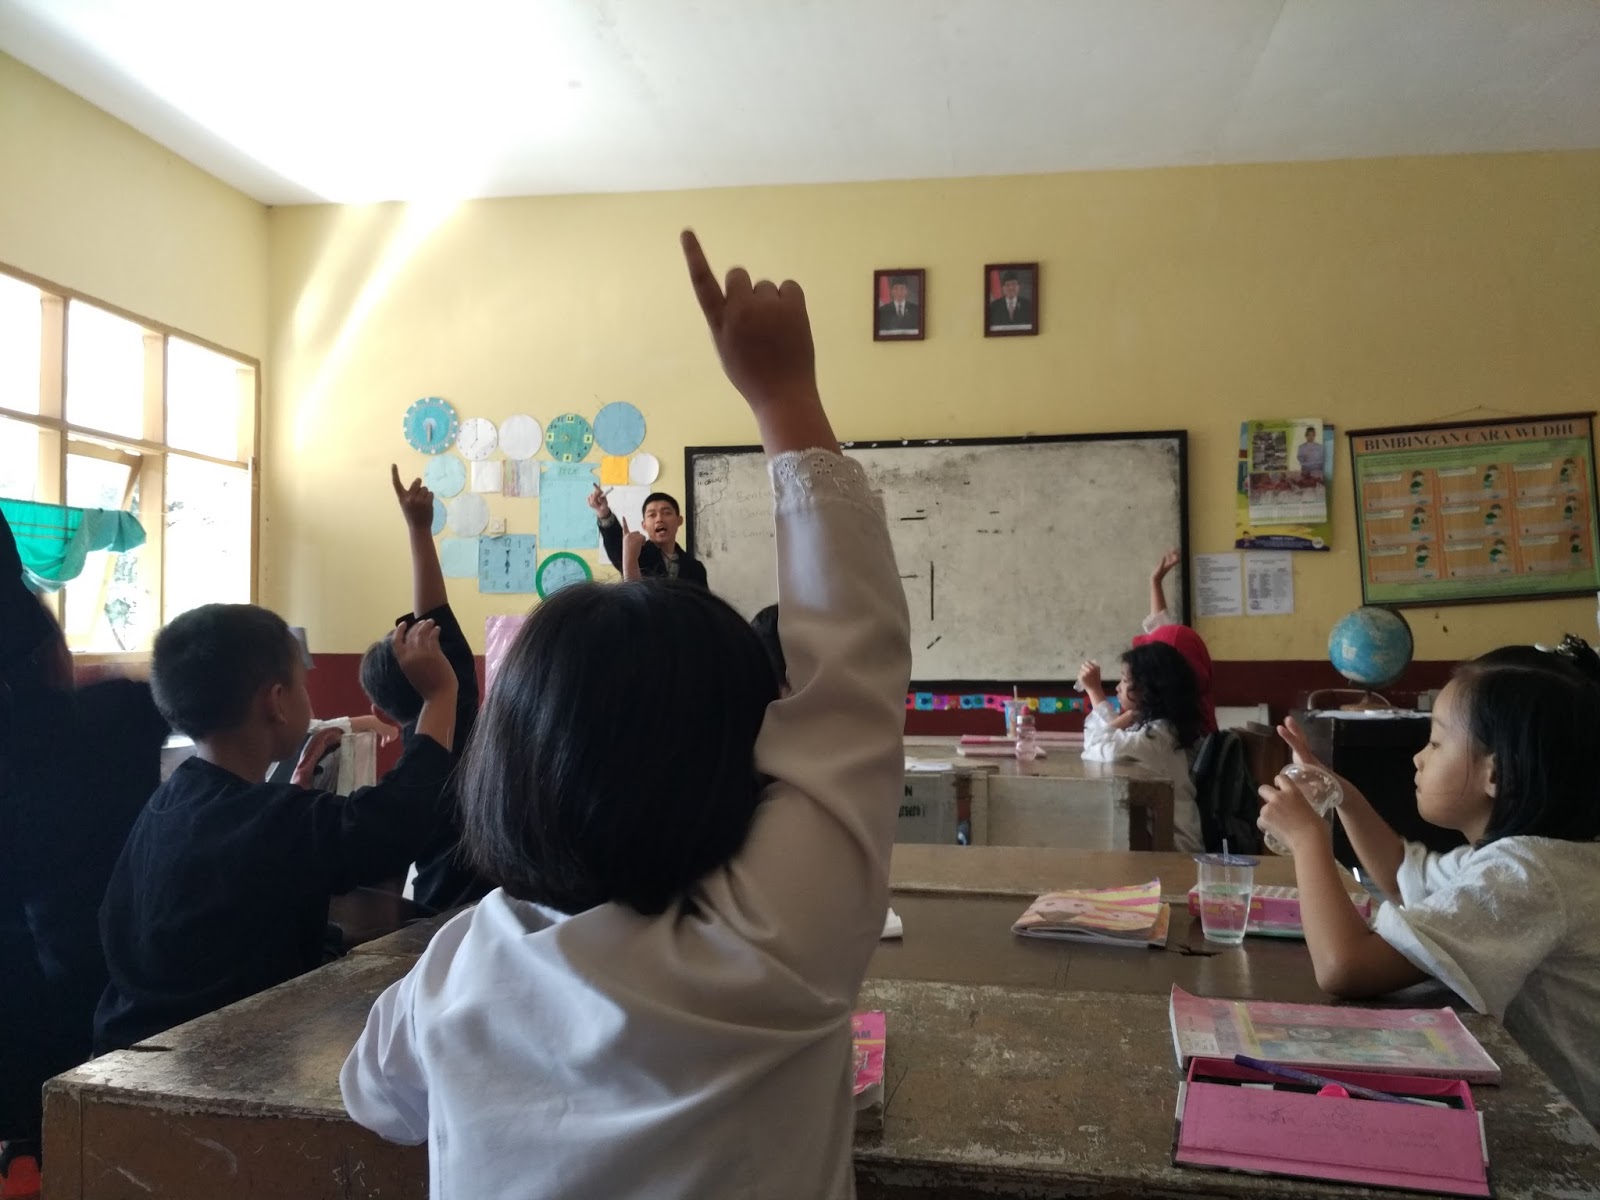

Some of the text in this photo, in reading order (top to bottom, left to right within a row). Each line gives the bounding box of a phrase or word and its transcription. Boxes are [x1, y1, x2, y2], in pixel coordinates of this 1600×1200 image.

[1364, 422, 1576, 451] BIMBINGAN CARA WUDHU
[503, 537, 512, 548] 12
[505, 581, 511, 589] 6
